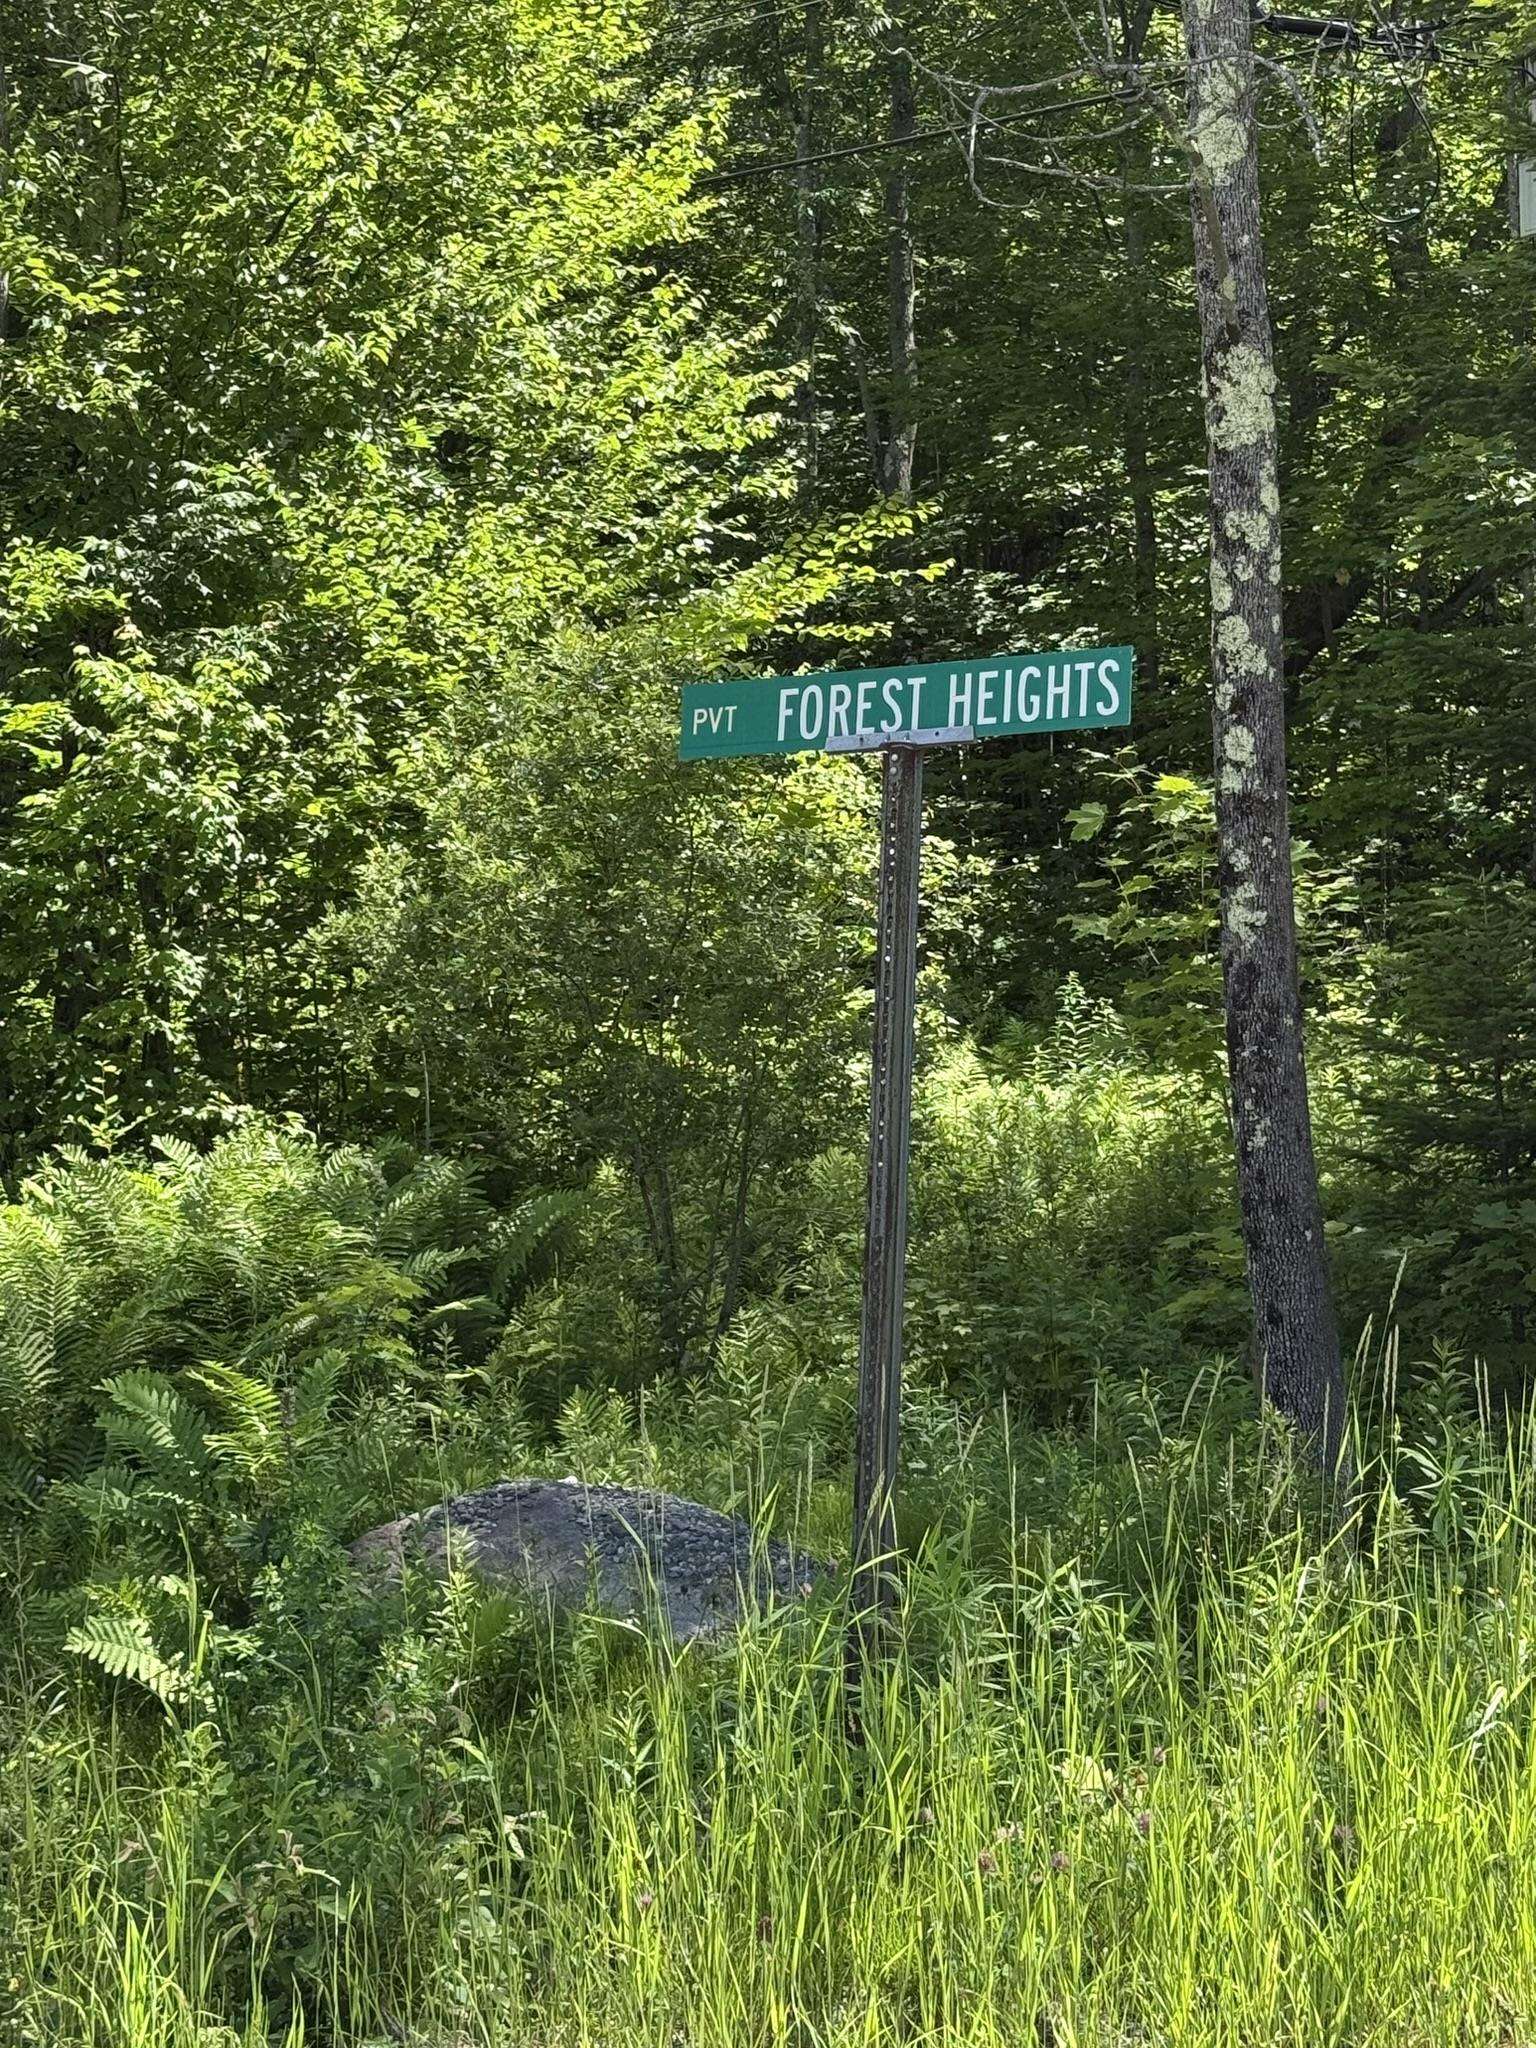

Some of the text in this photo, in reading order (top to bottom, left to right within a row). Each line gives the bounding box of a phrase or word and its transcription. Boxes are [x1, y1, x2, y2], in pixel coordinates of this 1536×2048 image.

[692, 658, 1120, 742] PVT FOREST HEIGHTS
